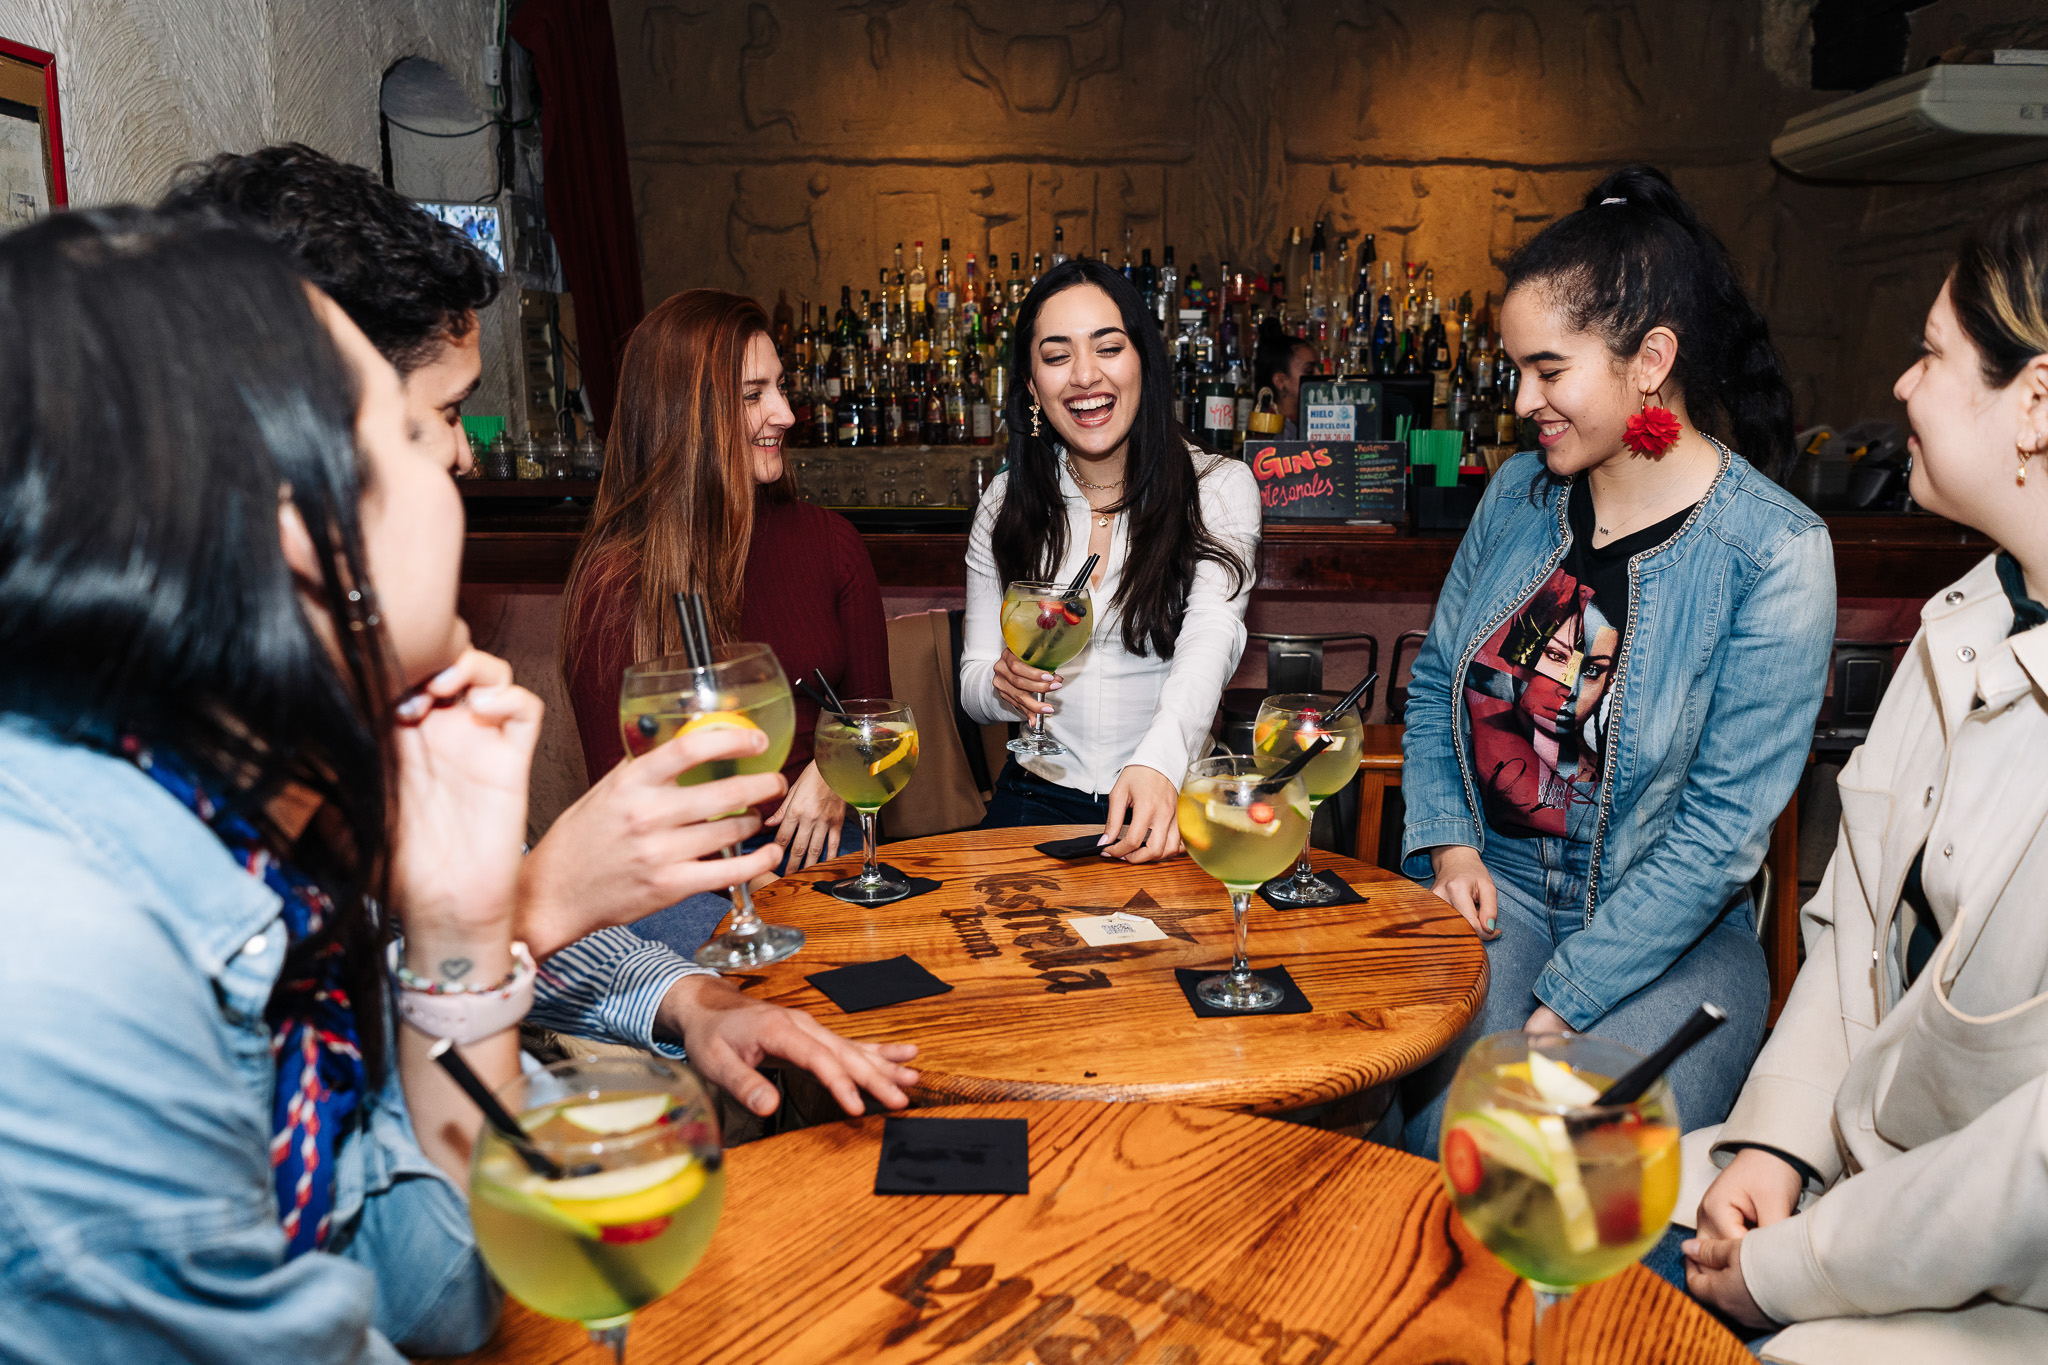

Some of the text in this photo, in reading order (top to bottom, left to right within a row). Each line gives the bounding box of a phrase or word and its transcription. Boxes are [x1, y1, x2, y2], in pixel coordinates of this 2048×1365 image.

[1310, 410, 1334, 418] HIELO
[1261, 472, 1334, 508] rtesanales
[940, 905, 1003, 959] Damm
